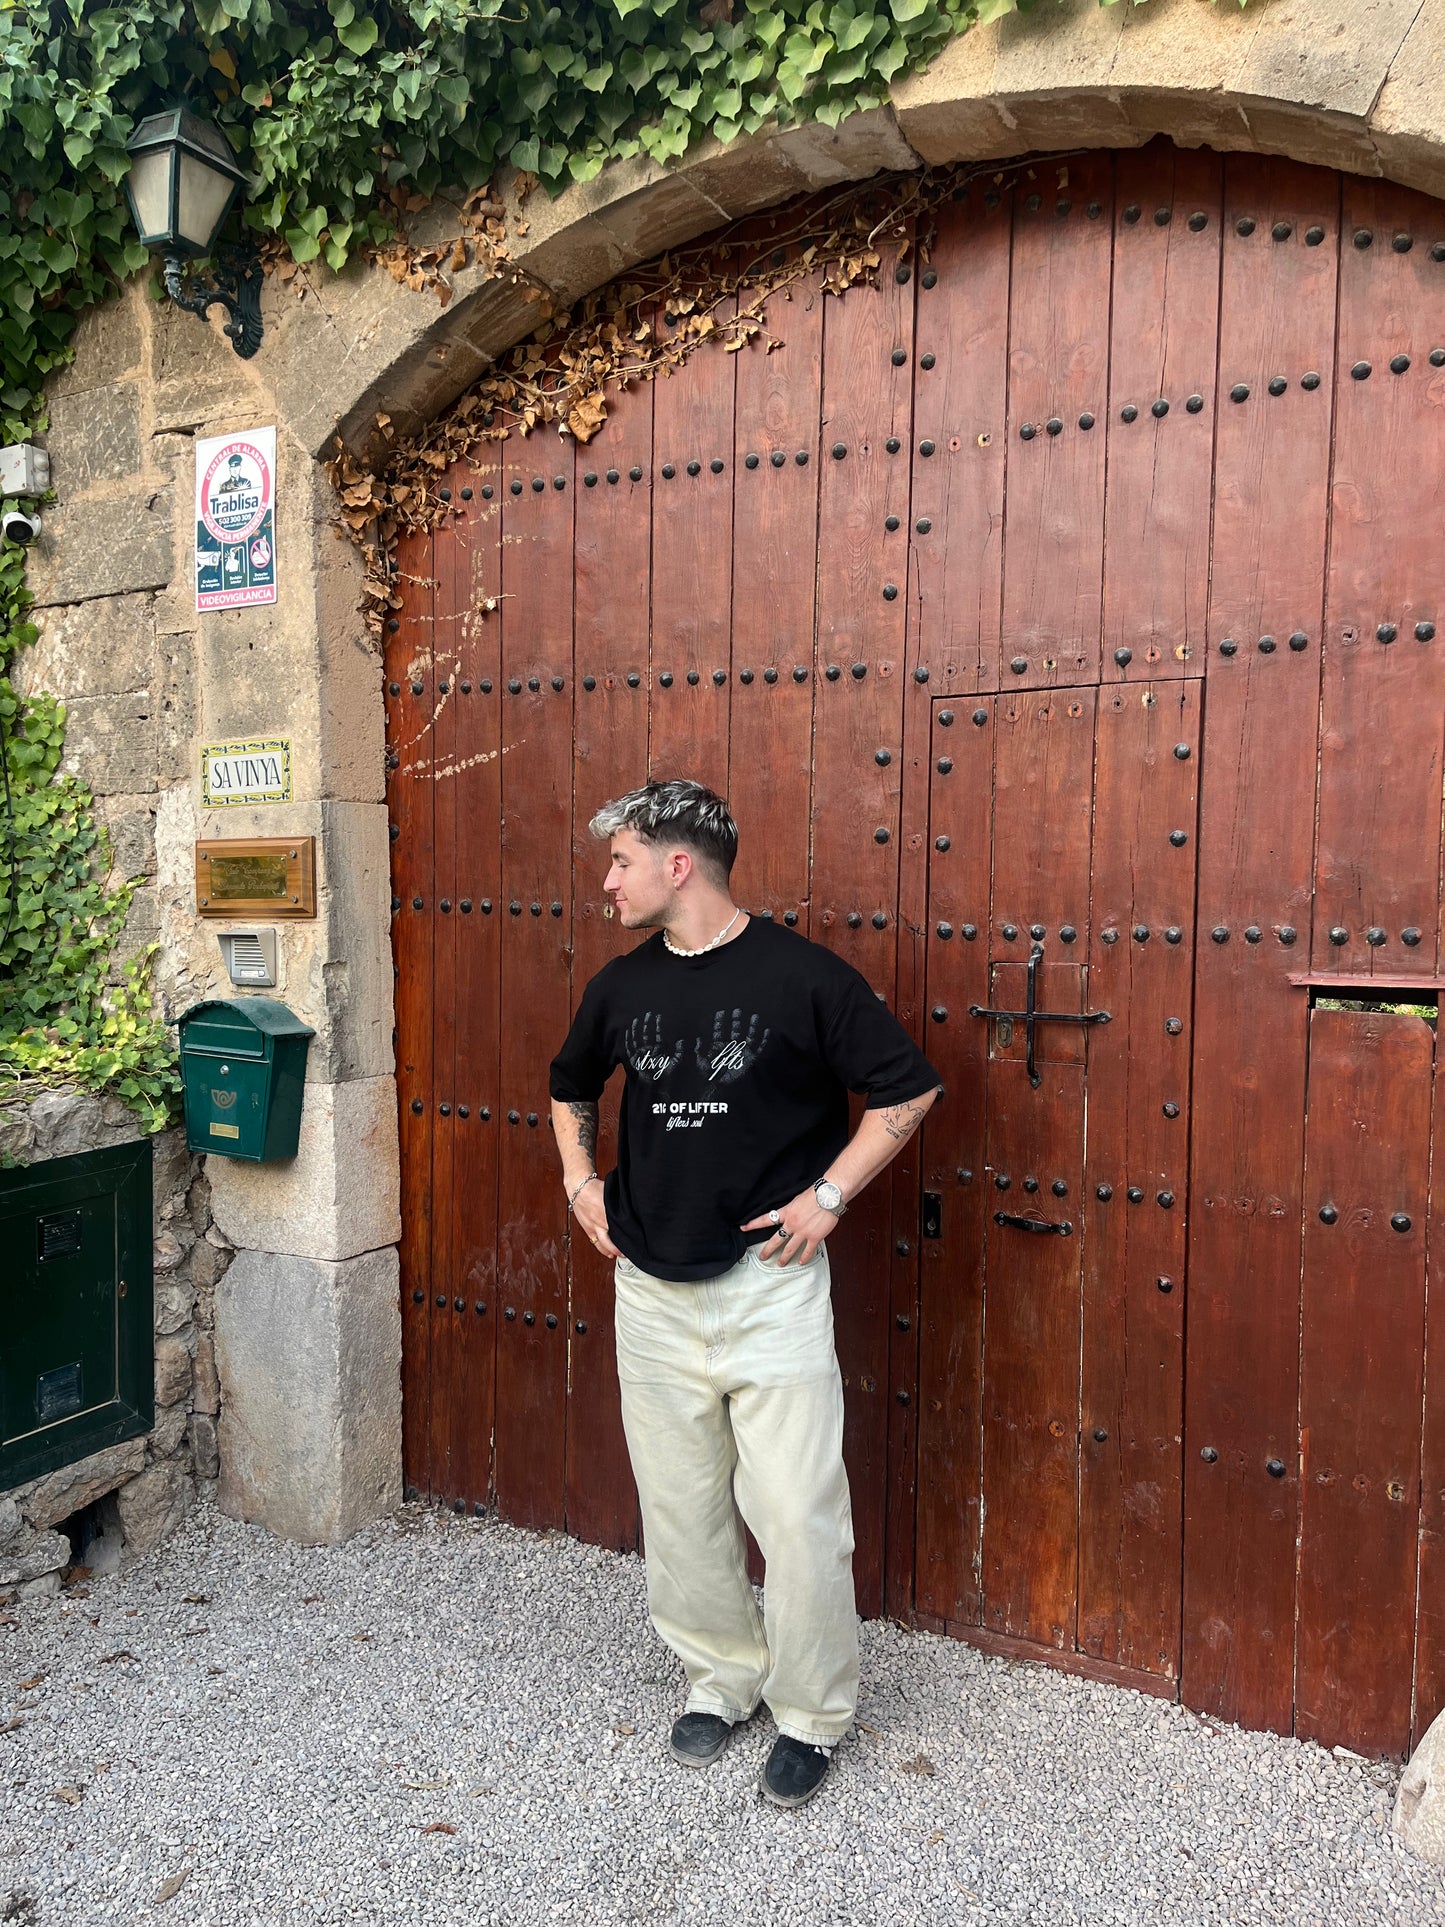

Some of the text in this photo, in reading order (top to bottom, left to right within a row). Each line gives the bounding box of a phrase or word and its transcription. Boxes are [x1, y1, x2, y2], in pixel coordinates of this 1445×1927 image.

[206, 445, 266, 480] CENTRAL DE ALARMA
[210, 493, 259, 515] Trablisa
[204, 502, 268, 540] VIGILANCIA PERMANENTE
[200, 588, 272, 606] VIDEOVIGILANCIA
[211, 757, 282, 789] SA VINYA
[670, 1102, 687, 1114] OF
[688, 1102, 728, 1114] LIFTER
